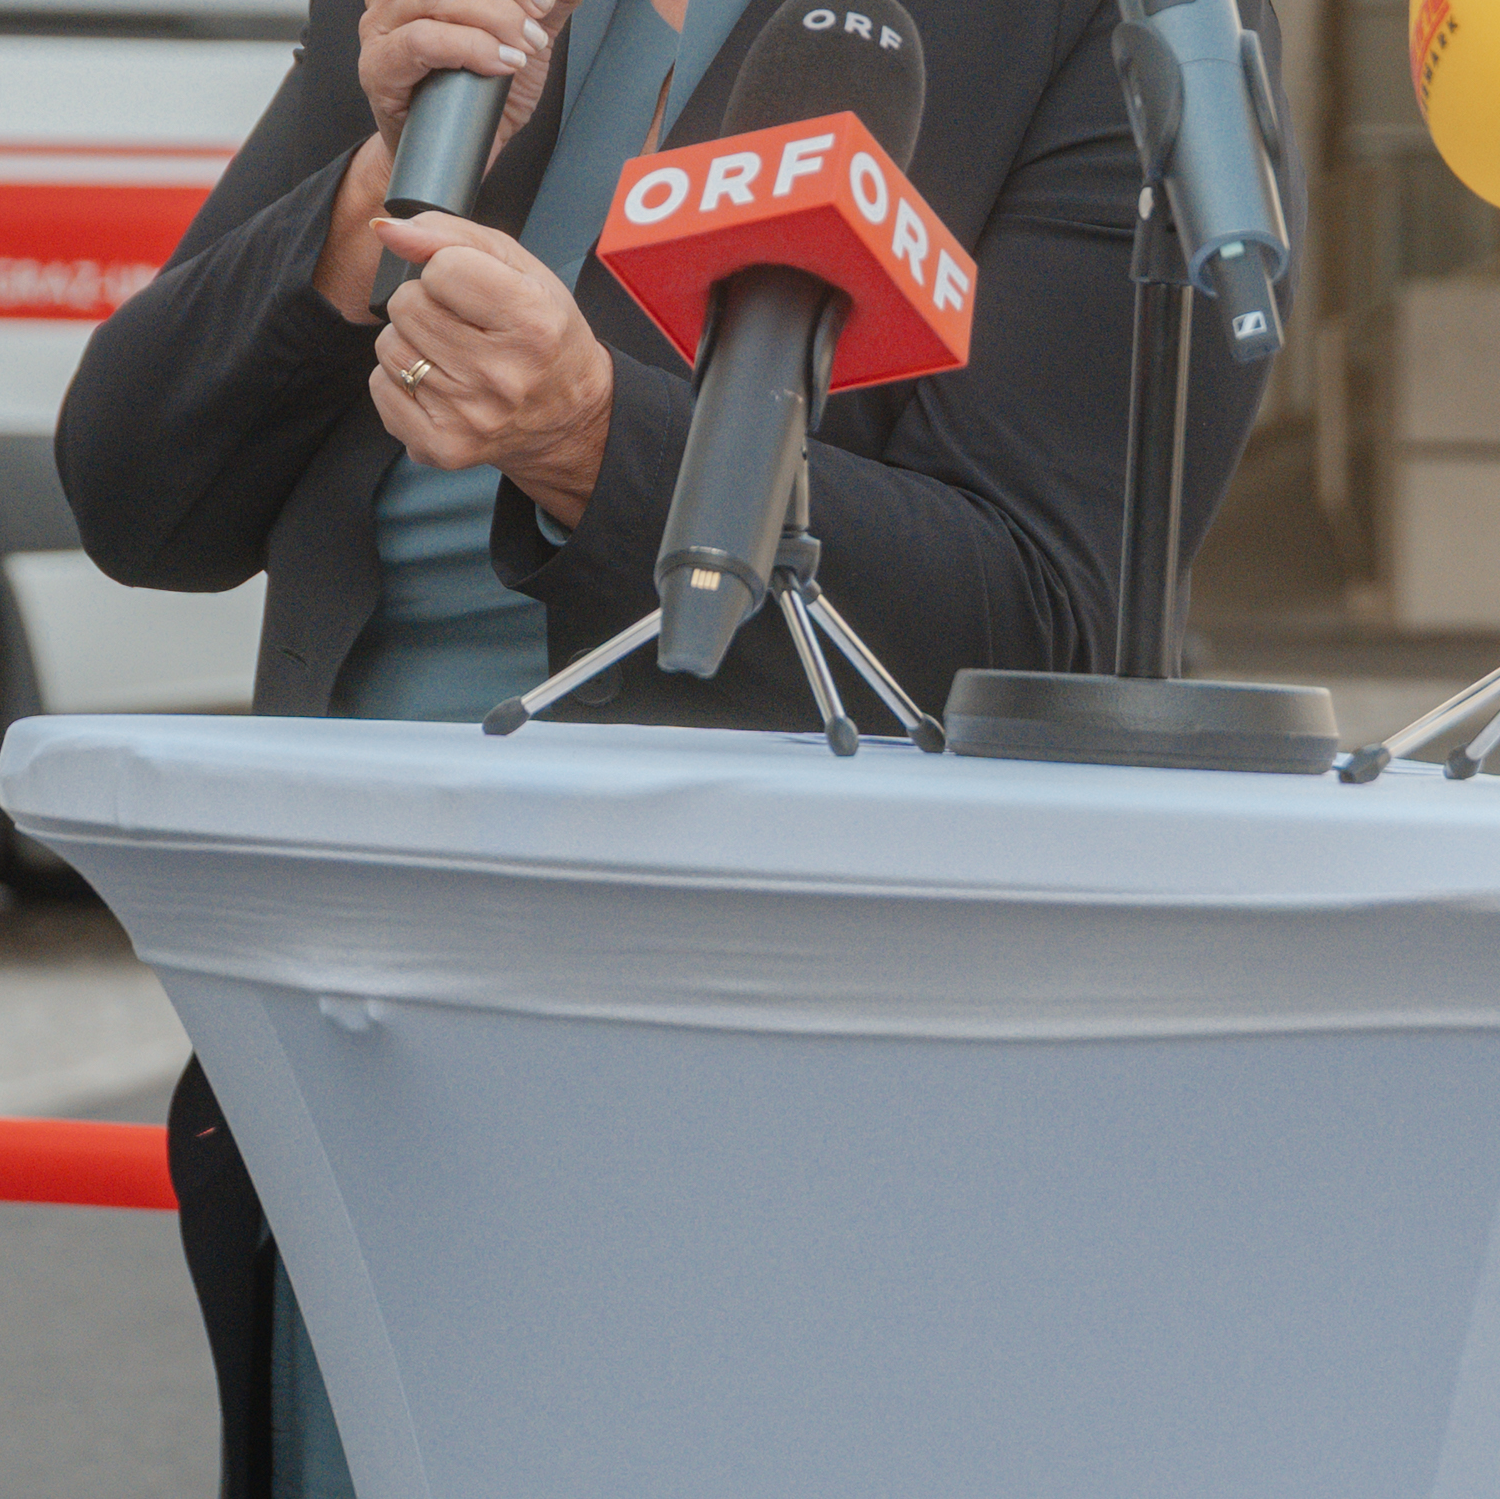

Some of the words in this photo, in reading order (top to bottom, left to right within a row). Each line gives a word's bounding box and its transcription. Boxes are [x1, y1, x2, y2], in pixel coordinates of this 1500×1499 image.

[803, 8, 903, 50] ORF
[623, 132, 835, 225] ORF
[850, 151, 969, 311] ORF
